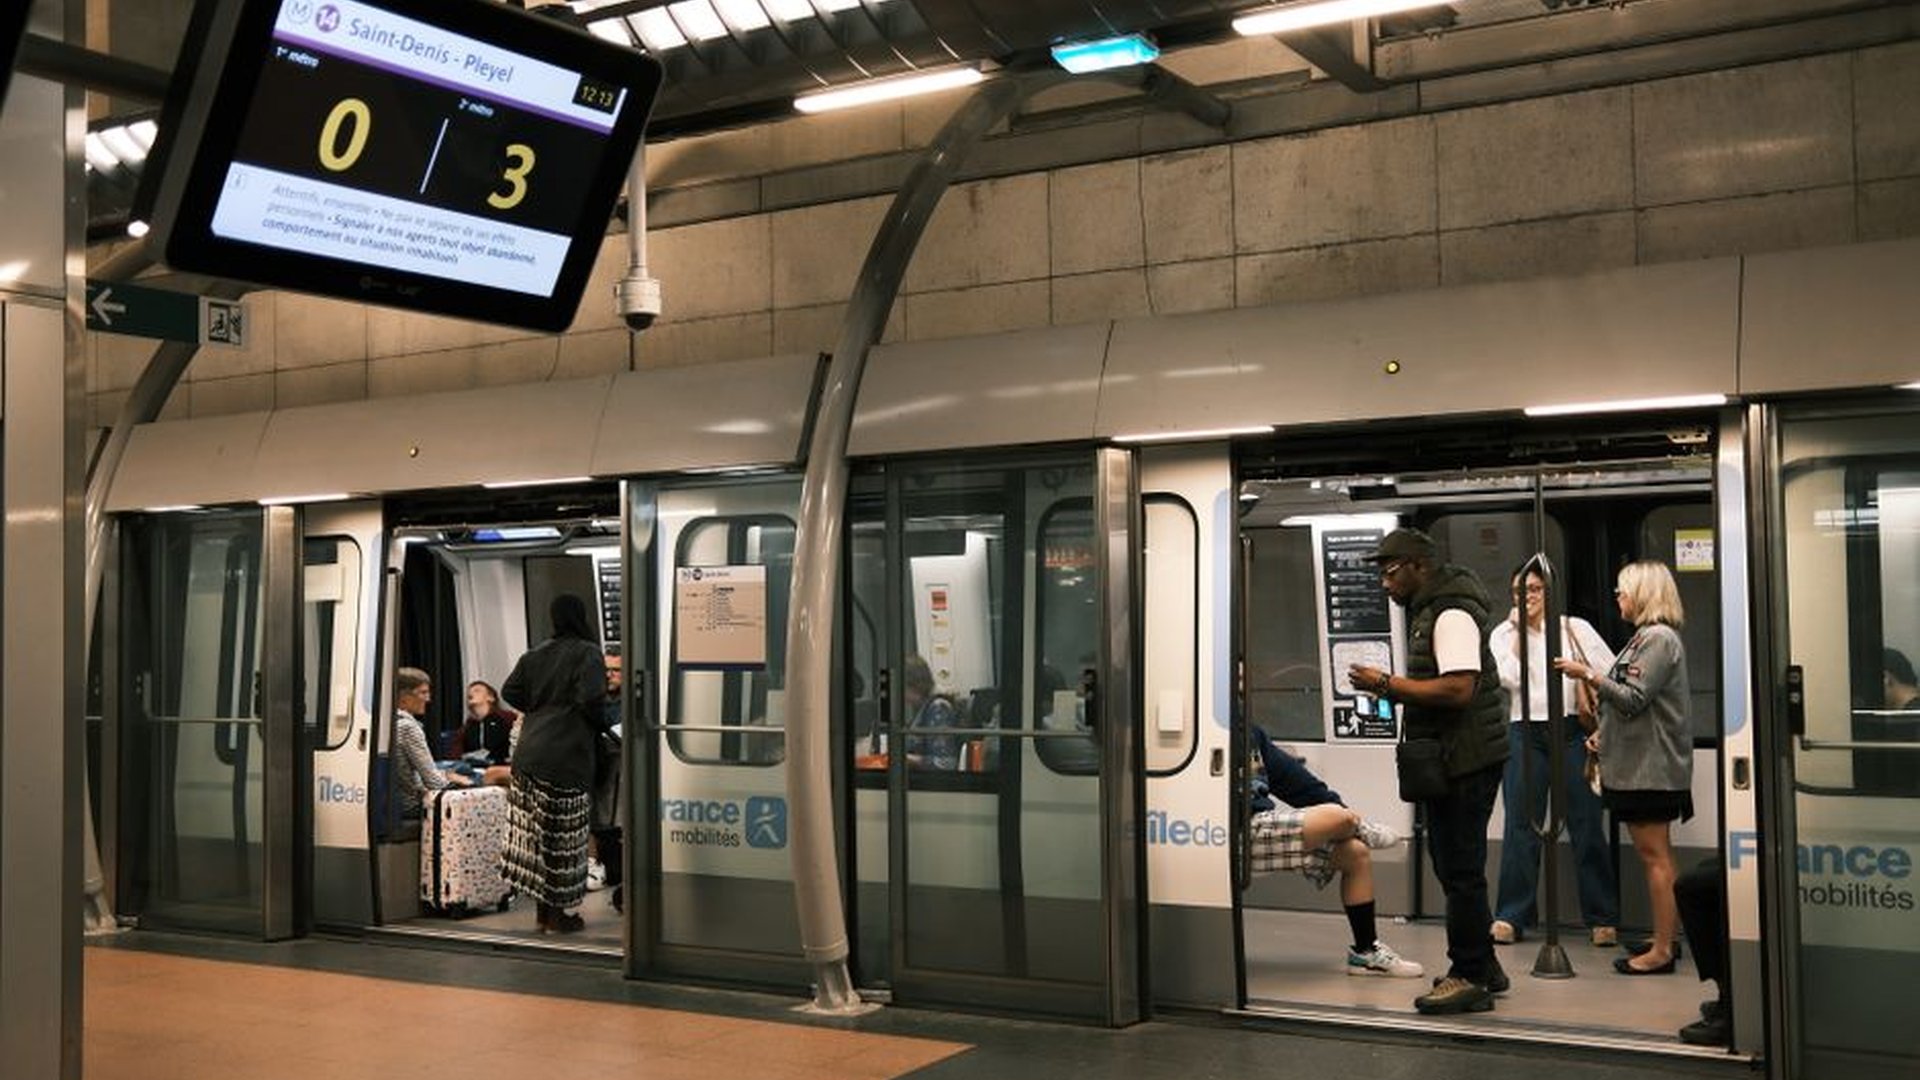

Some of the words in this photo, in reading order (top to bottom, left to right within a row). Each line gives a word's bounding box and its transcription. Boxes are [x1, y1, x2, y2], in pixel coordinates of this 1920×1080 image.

[318, 10, 338, 29] 14
[351, 18, 450, 63] Saint-Denis
[464, 54, 513, 83] Pleyel
[319, 98, 371, 171] 0
[487, 144, 535, 209] 3
[662, 798, 740, 824] rance
[670, 827, 740, 847] mobilités
[1729, 831, 1912, 878] Fance
